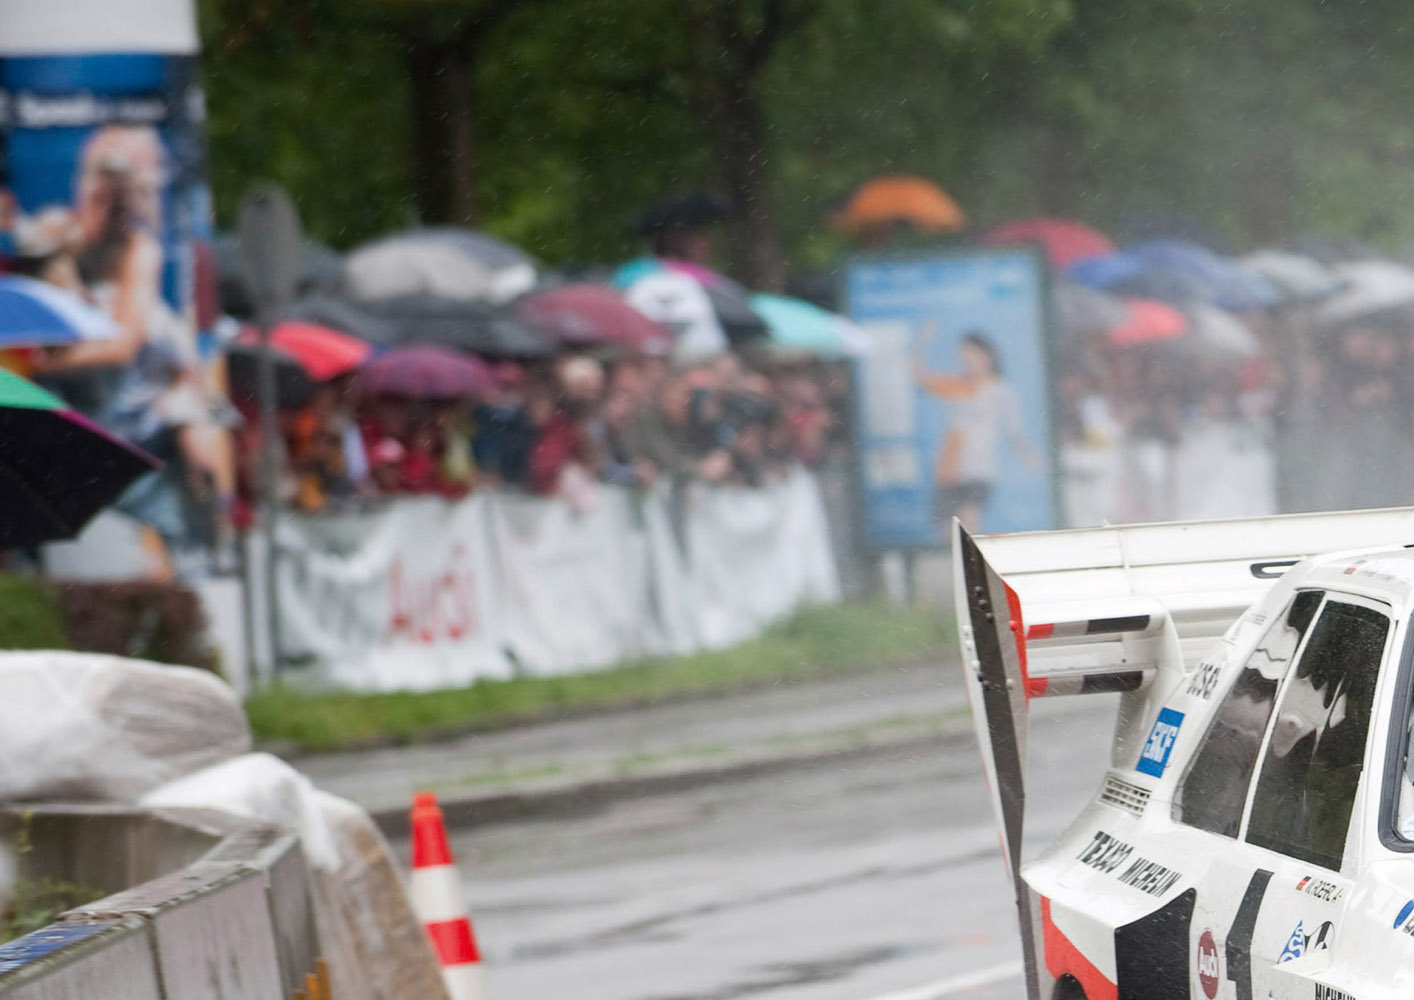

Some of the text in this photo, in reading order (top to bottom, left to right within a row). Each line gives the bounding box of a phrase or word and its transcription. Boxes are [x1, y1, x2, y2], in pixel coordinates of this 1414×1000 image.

[1143, 721, 1180, 763] SKF
[1117, 857, 1182, 898] MICHELIN
[1199, 946, 1219, 979] Audi
